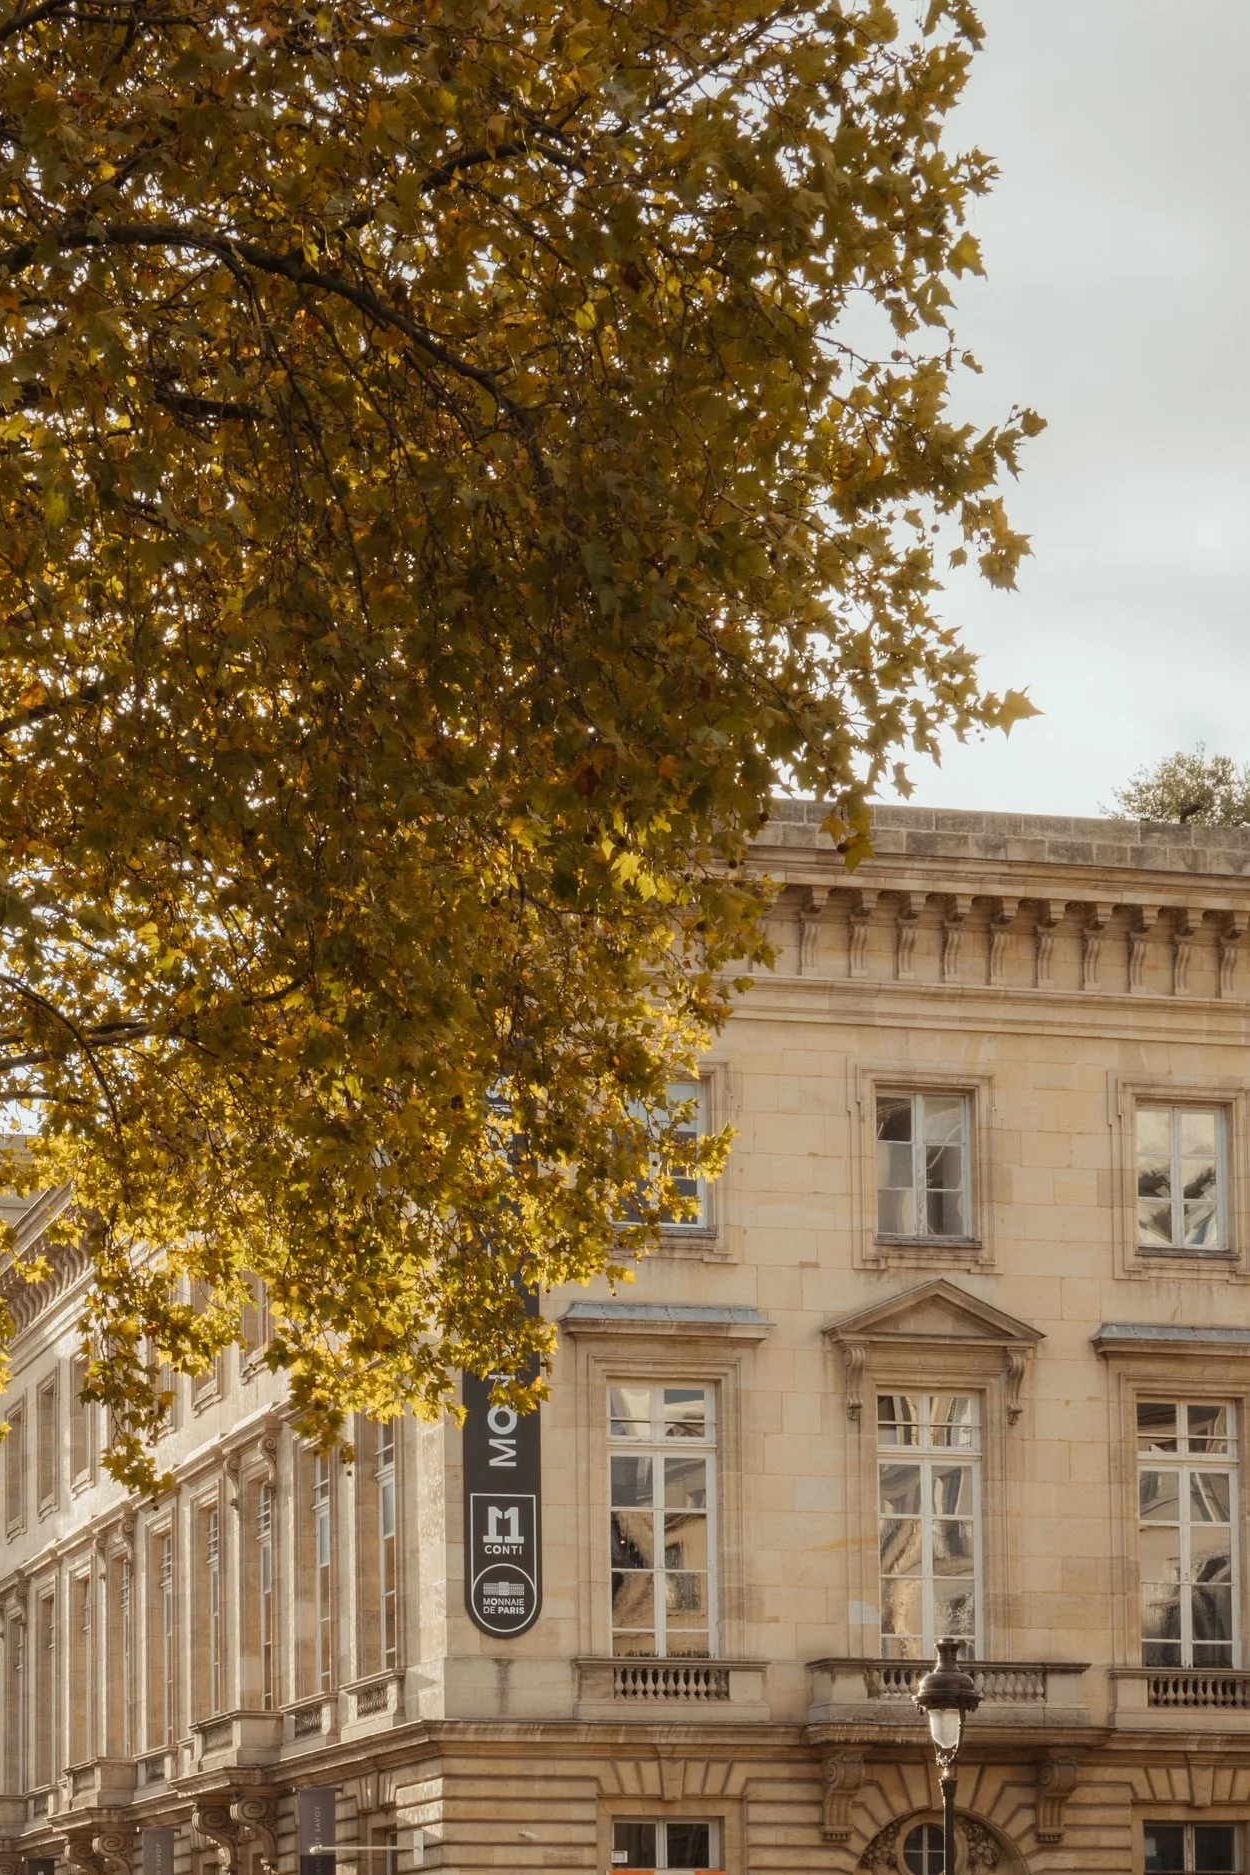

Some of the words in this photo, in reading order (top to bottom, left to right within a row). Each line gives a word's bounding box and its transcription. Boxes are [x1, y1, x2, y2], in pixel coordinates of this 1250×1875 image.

[484, 1545, 522, 1554] CONTI
[483, 1598, 524, 1606] MONNAIE
[483, 1606, 496, 1614] DE
[498, 1606, 525, 1615] PARIS
